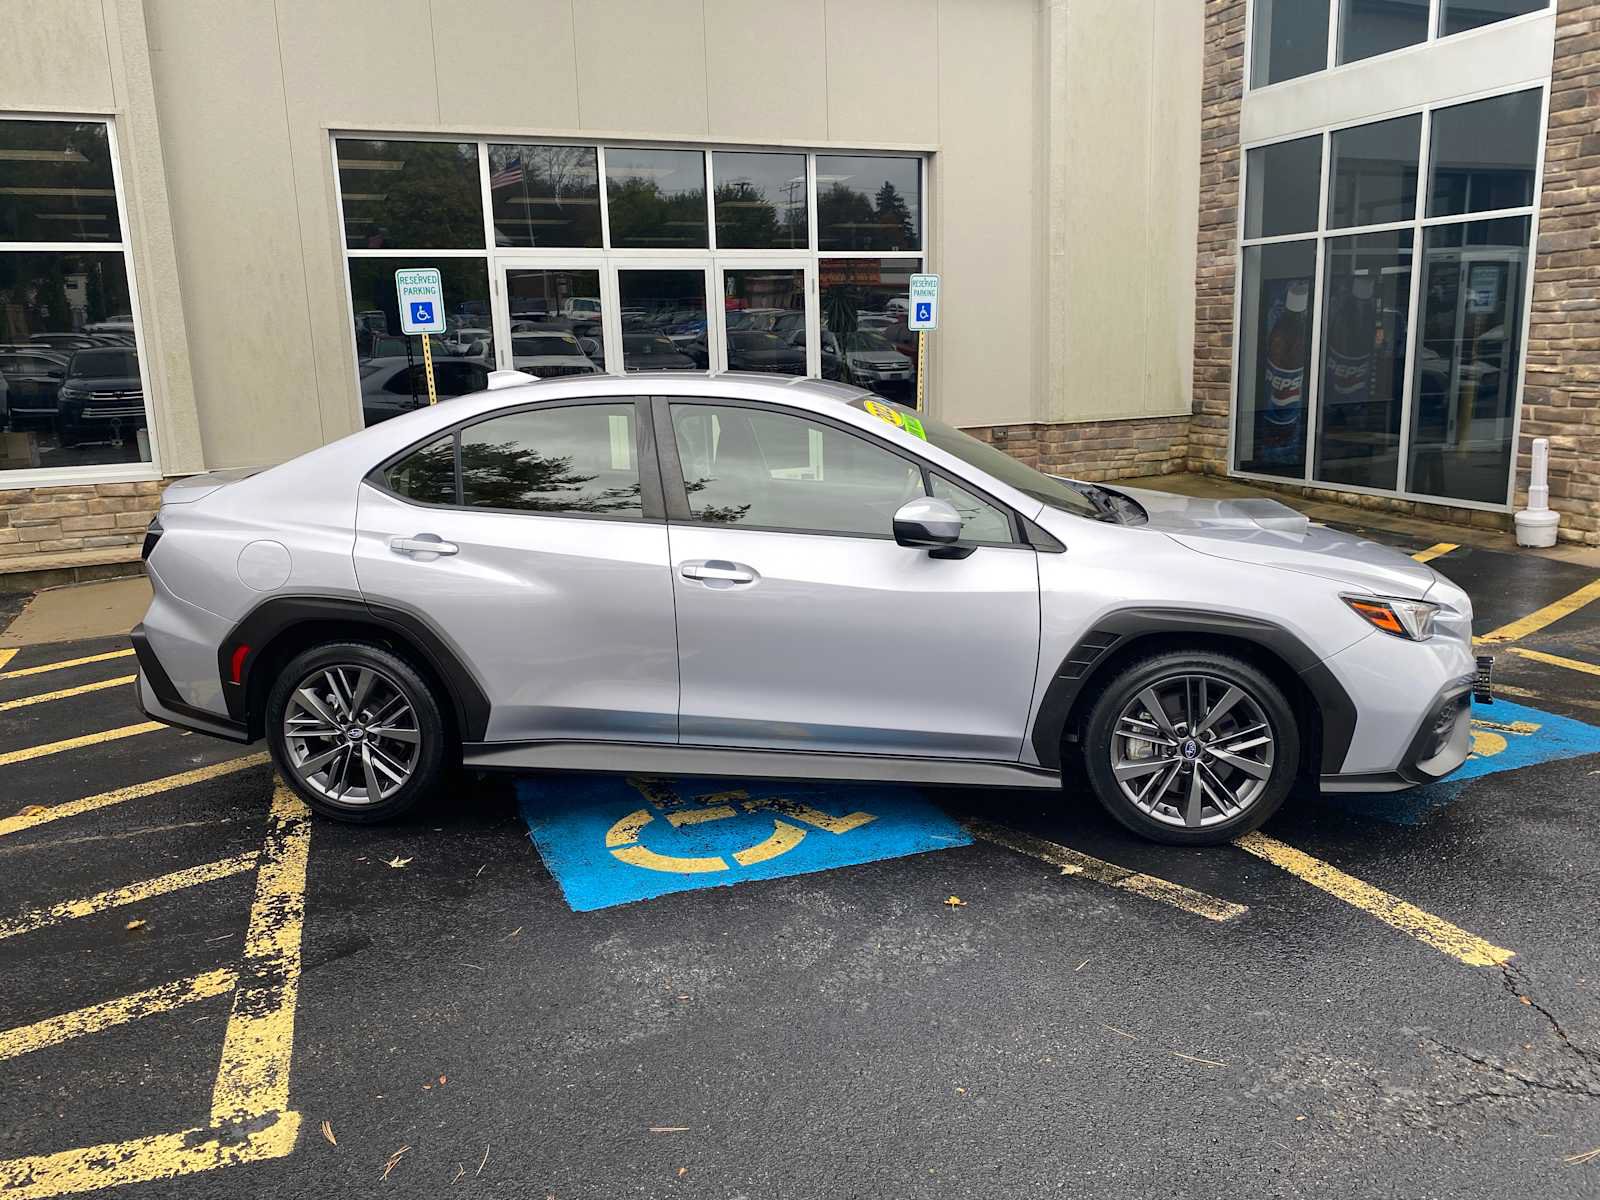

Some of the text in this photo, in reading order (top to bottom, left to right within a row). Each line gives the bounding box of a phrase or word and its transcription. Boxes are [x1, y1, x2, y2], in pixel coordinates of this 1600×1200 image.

[399, 275, 437, 285] RESERVED
[912, 280, 937, 288] RESERVED
[403, 286, 436, 296] PARKING
[913, 289, 936, 297] PARKING
